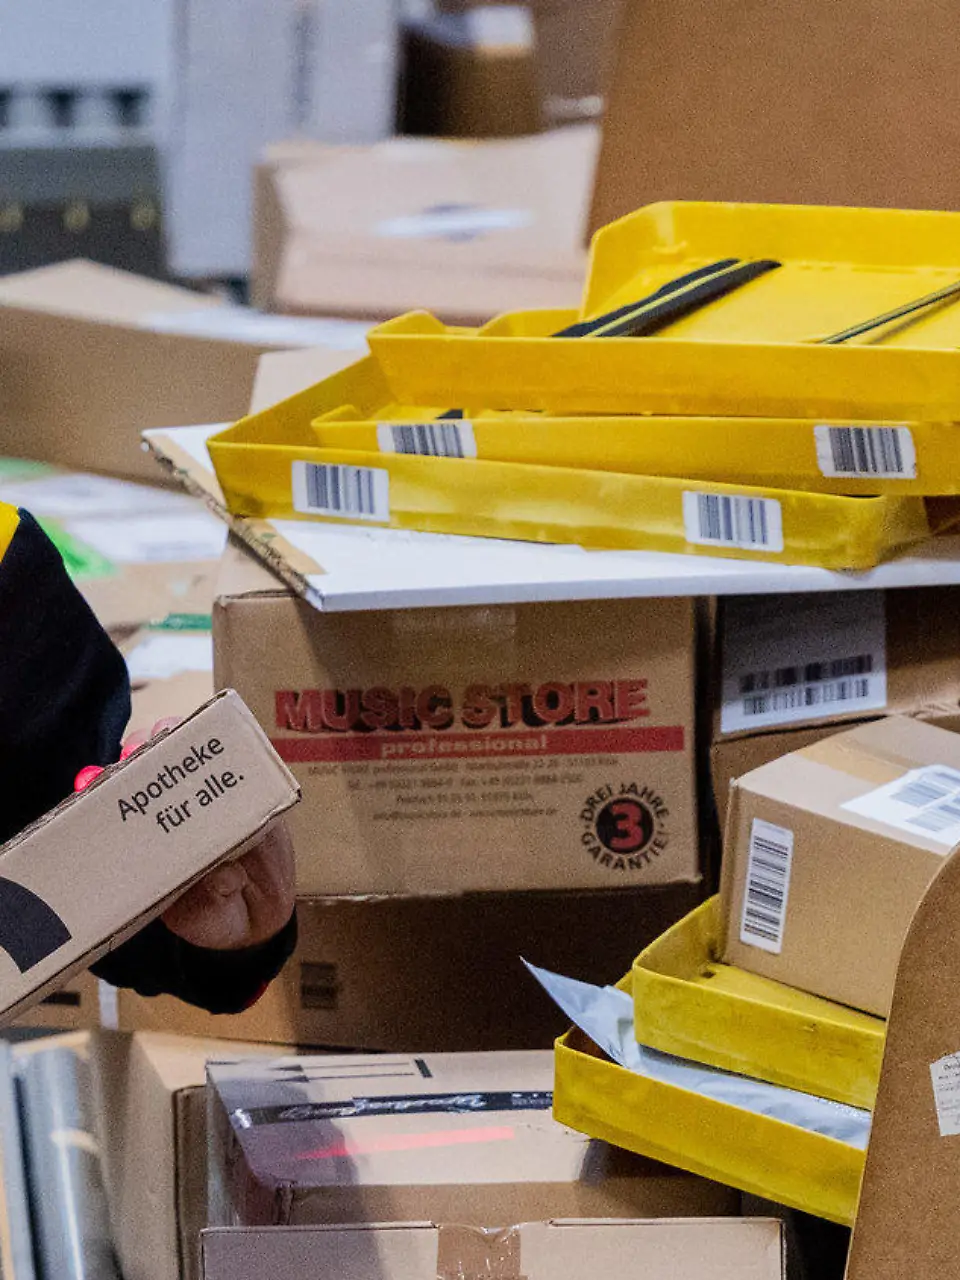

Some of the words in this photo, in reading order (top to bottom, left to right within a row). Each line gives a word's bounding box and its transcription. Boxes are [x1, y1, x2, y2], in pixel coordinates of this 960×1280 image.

[275, 684, 455, 733] MUSIC
[461, 678, 651, 730] STORE
[380, 733, 548, 758] professional
[117, 737, 225, 822] Apotheke
[155, 800, 192, 834] für
[195, 771, 245, 808] alle.
[581, 784, 614, 820] DREI
[619, 782, 670, 819] JAHRE
[610, 802, 645, 849] 3
